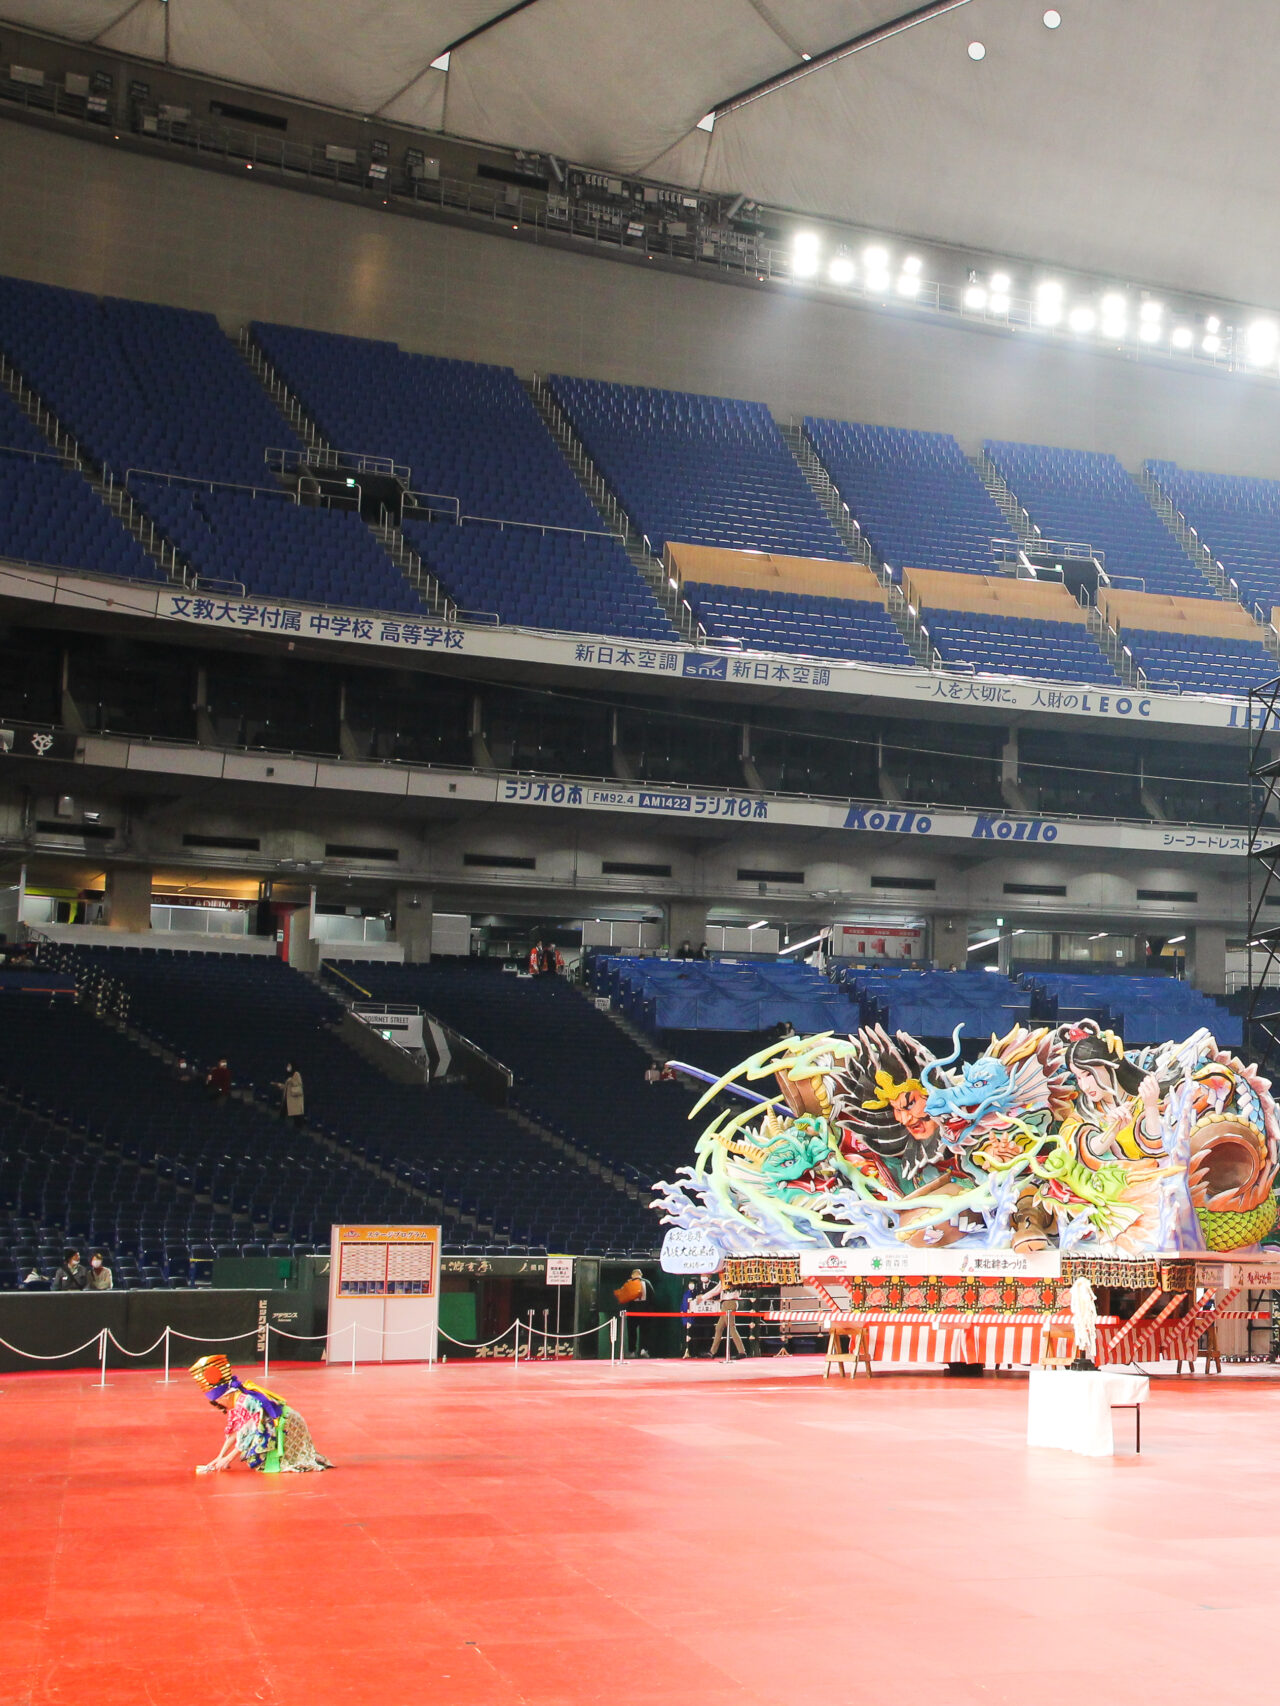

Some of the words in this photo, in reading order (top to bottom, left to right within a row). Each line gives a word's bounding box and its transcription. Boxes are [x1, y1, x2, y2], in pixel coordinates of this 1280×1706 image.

[170, 595, 302, 632] 文教大学付属
[309, 612, 374, 641] 中学校
[379, 621, 466, 650] 高等学校
[574, 643, 678, 672] 新日本空調
[731, 660, 832, 687] 新日本空調
[504, 779, 583, 805] ラジオ日本
[593, 792, 635, 805] FM92.4
[641, 795, 688, 810] AM1422
[694, 796, 768, 819] ラジオ日本
[178, 898, 231, 909] STADIUM
[390, 1016, 409, 1024] STREET
